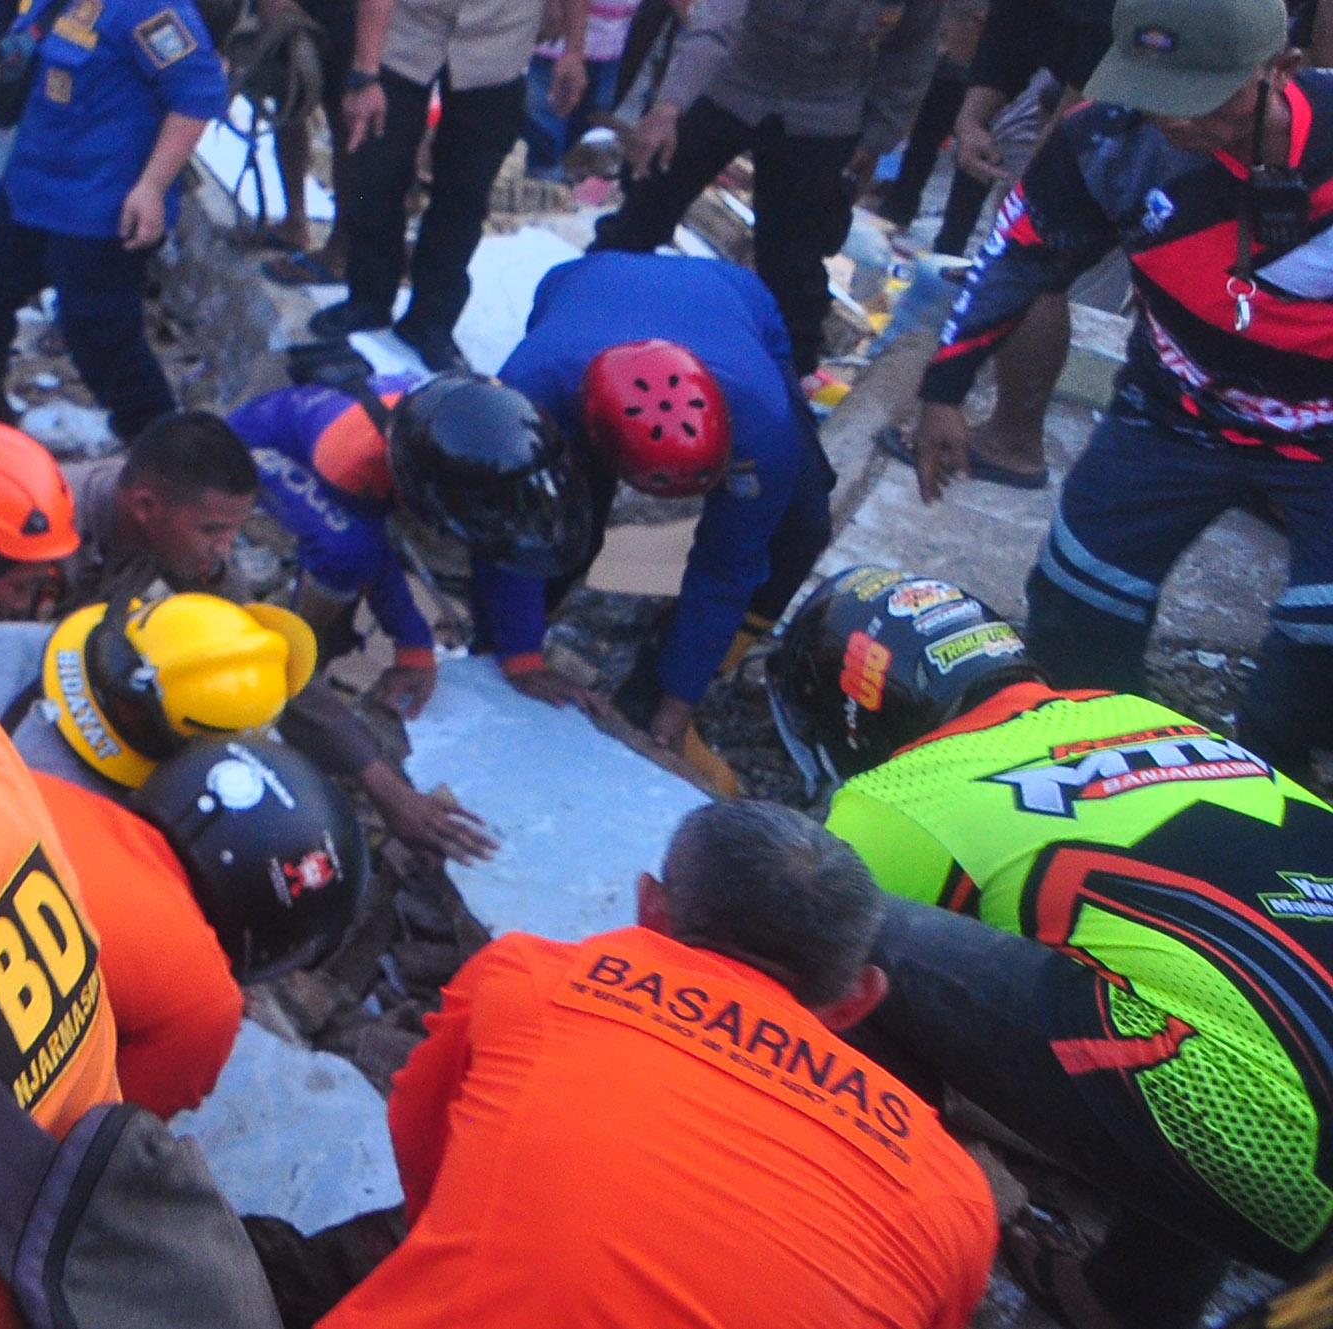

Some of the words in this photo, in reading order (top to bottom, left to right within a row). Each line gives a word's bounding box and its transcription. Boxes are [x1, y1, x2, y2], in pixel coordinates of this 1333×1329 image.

[57, 650, 120, 759] HIDAYAT
[13, 972, 101, 1109] NJARMAS
[587, 954, 912, 1140] BASARNAS
